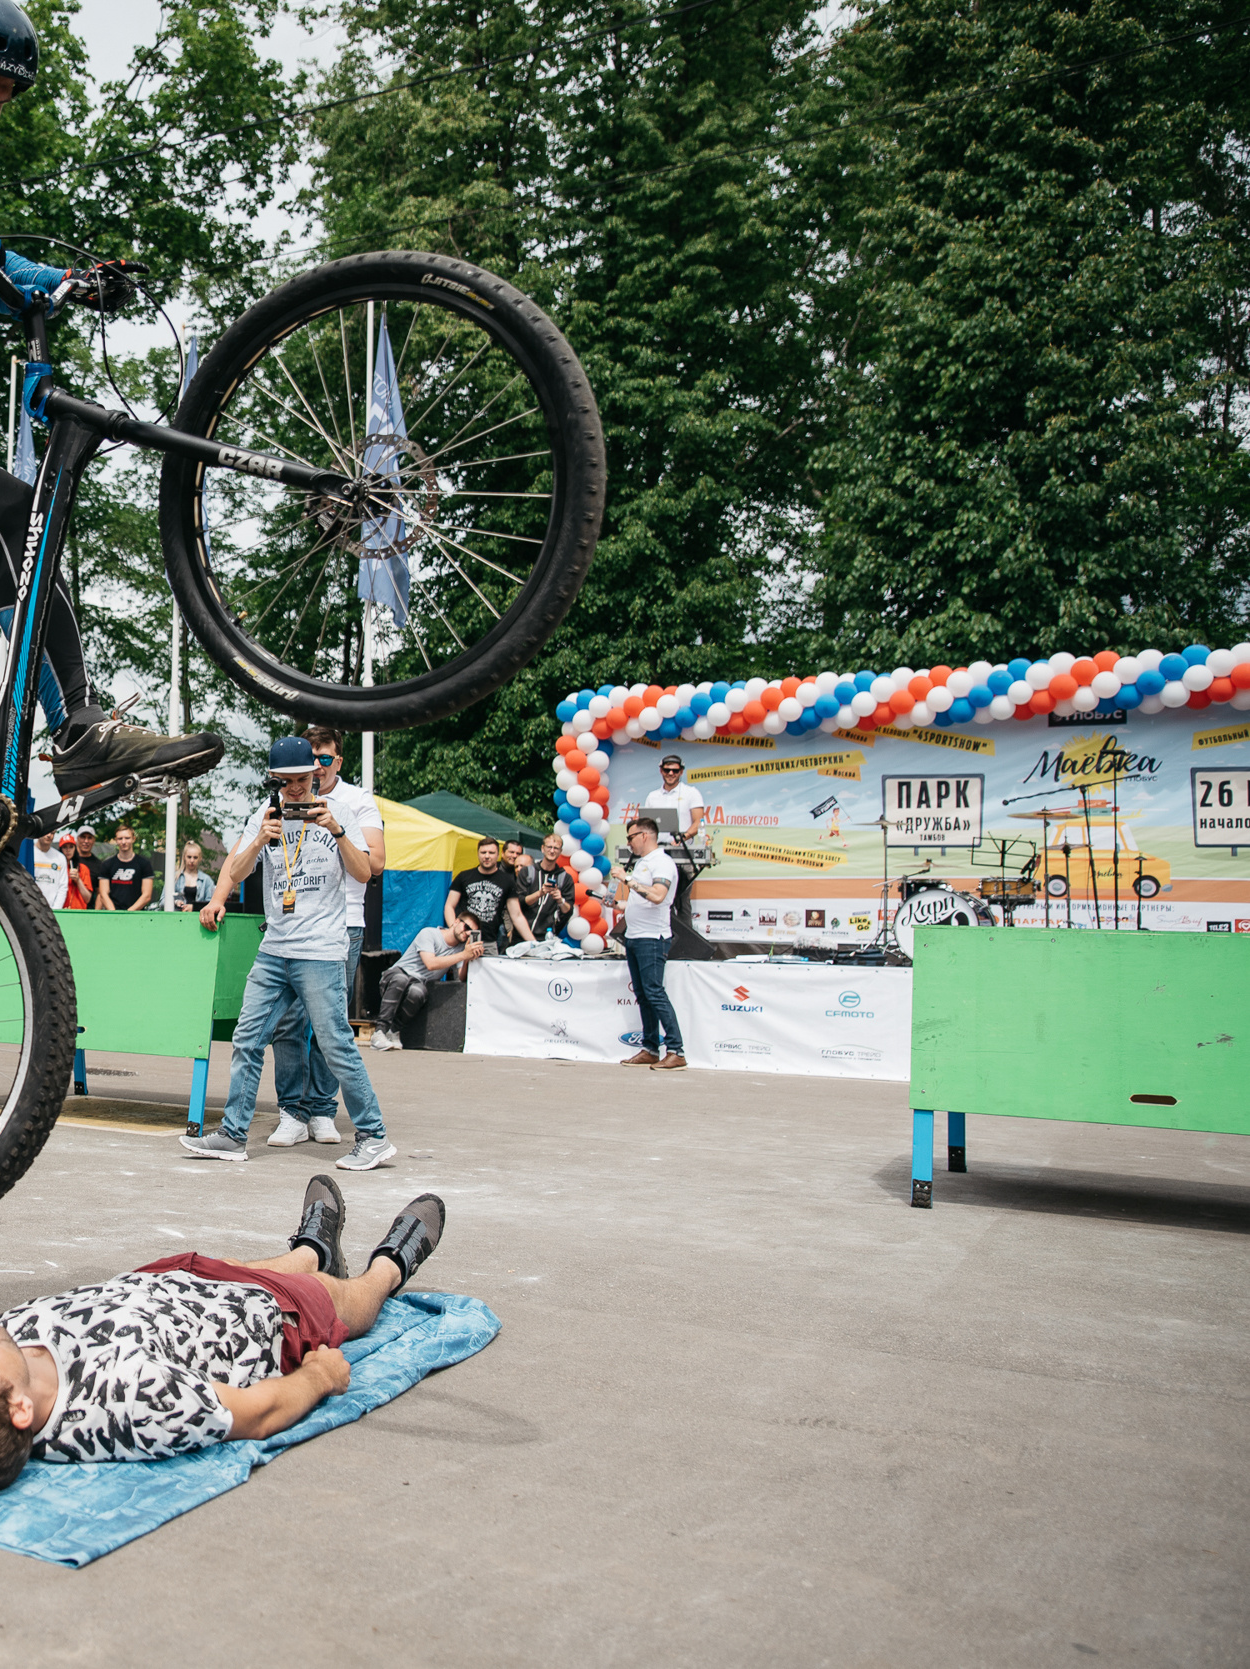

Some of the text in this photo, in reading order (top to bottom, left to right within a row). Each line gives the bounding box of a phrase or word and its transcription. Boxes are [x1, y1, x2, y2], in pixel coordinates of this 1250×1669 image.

[218, 447, 284, 479] CZAR
[1023, 735, 1163, 784] Маёвка
[897, 780, 970, 809] ПАРК
[1199, 780, 1233, 808] 26
[896, 817, 971, 834] «ДРУЖБА»
[1199, 818, 1250, 829] начало
[313, 830, 338, 852] SAIL
[273, 880, 287, 891] AND
[303, 875, 327, 885] DRIFT
[850, 917, 867, 925] Like
[554, 983, 569, 996] 0+
[617, 998, 631, 1006] KIA
[721, 1004, 763, 1013] SUZUKI
[825, 1010, 874, 1019] CFMOTO
